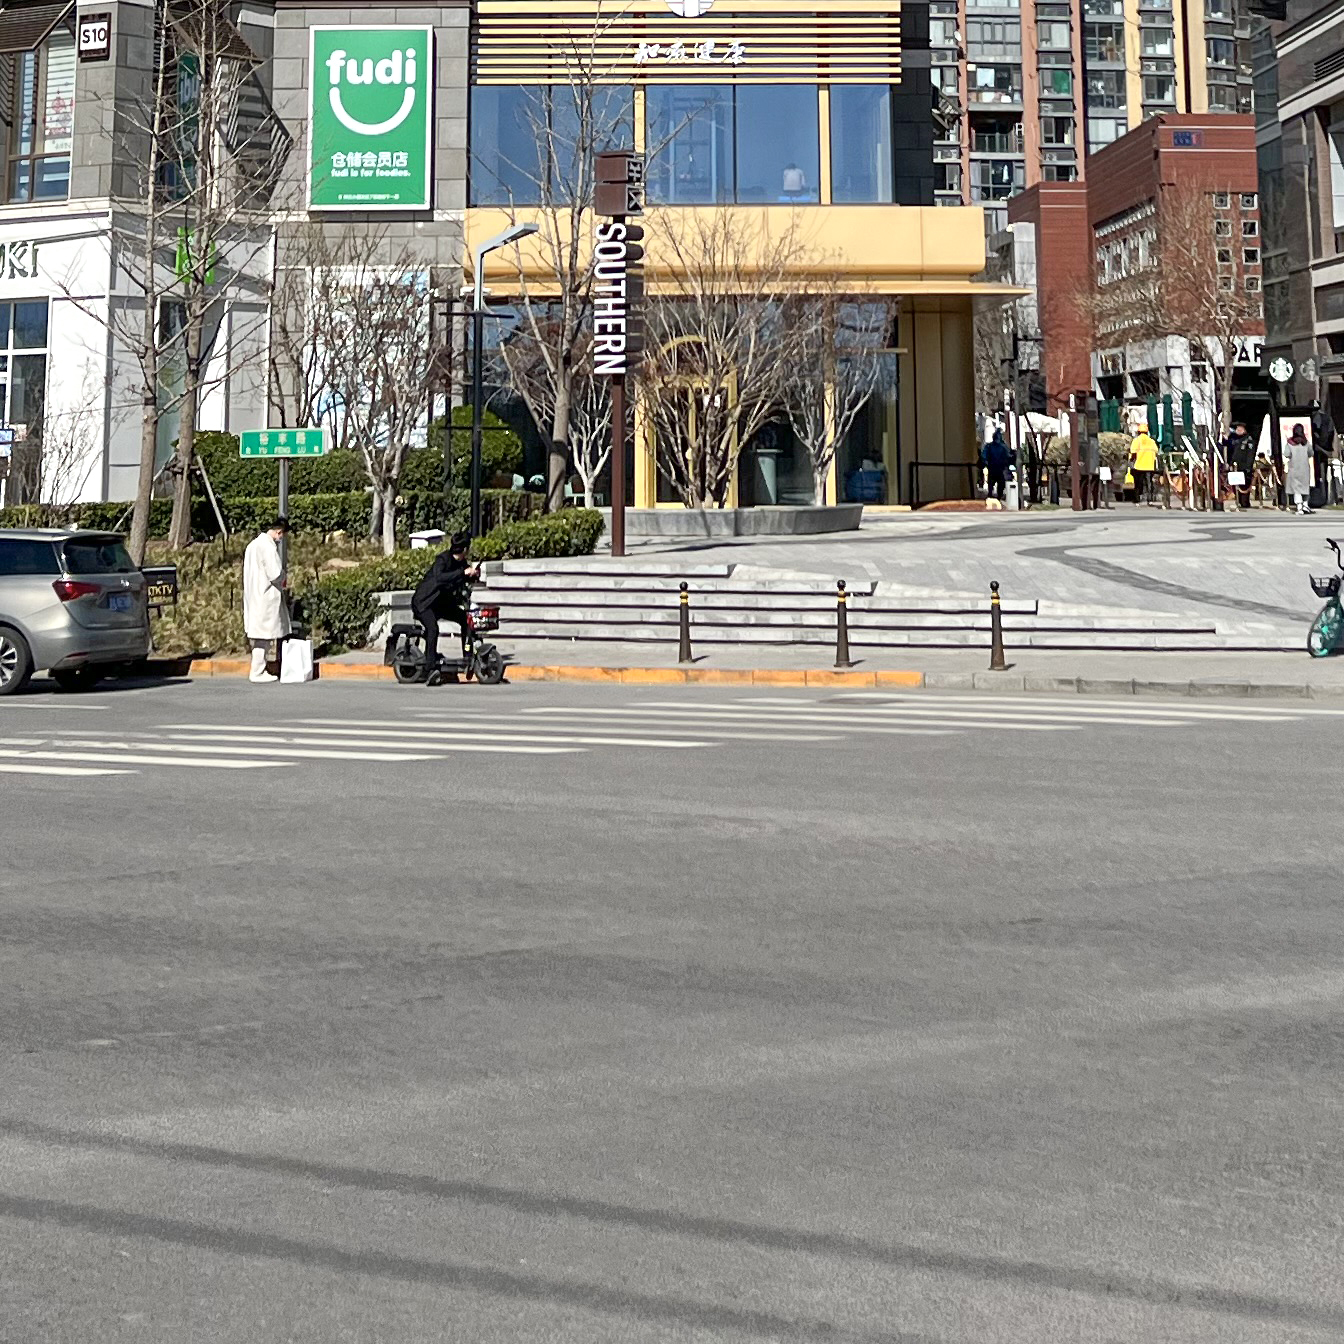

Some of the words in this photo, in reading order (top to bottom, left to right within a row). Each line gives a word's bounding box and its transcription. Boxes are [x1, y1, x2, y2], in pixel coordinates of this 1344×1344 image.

[82, 27, 107, 44] S10
[325, 48, 417, 85] fudi
[330, 151, 409, 168] 仓储会员店
[594, 223, 627, 375] SOUTHERN
